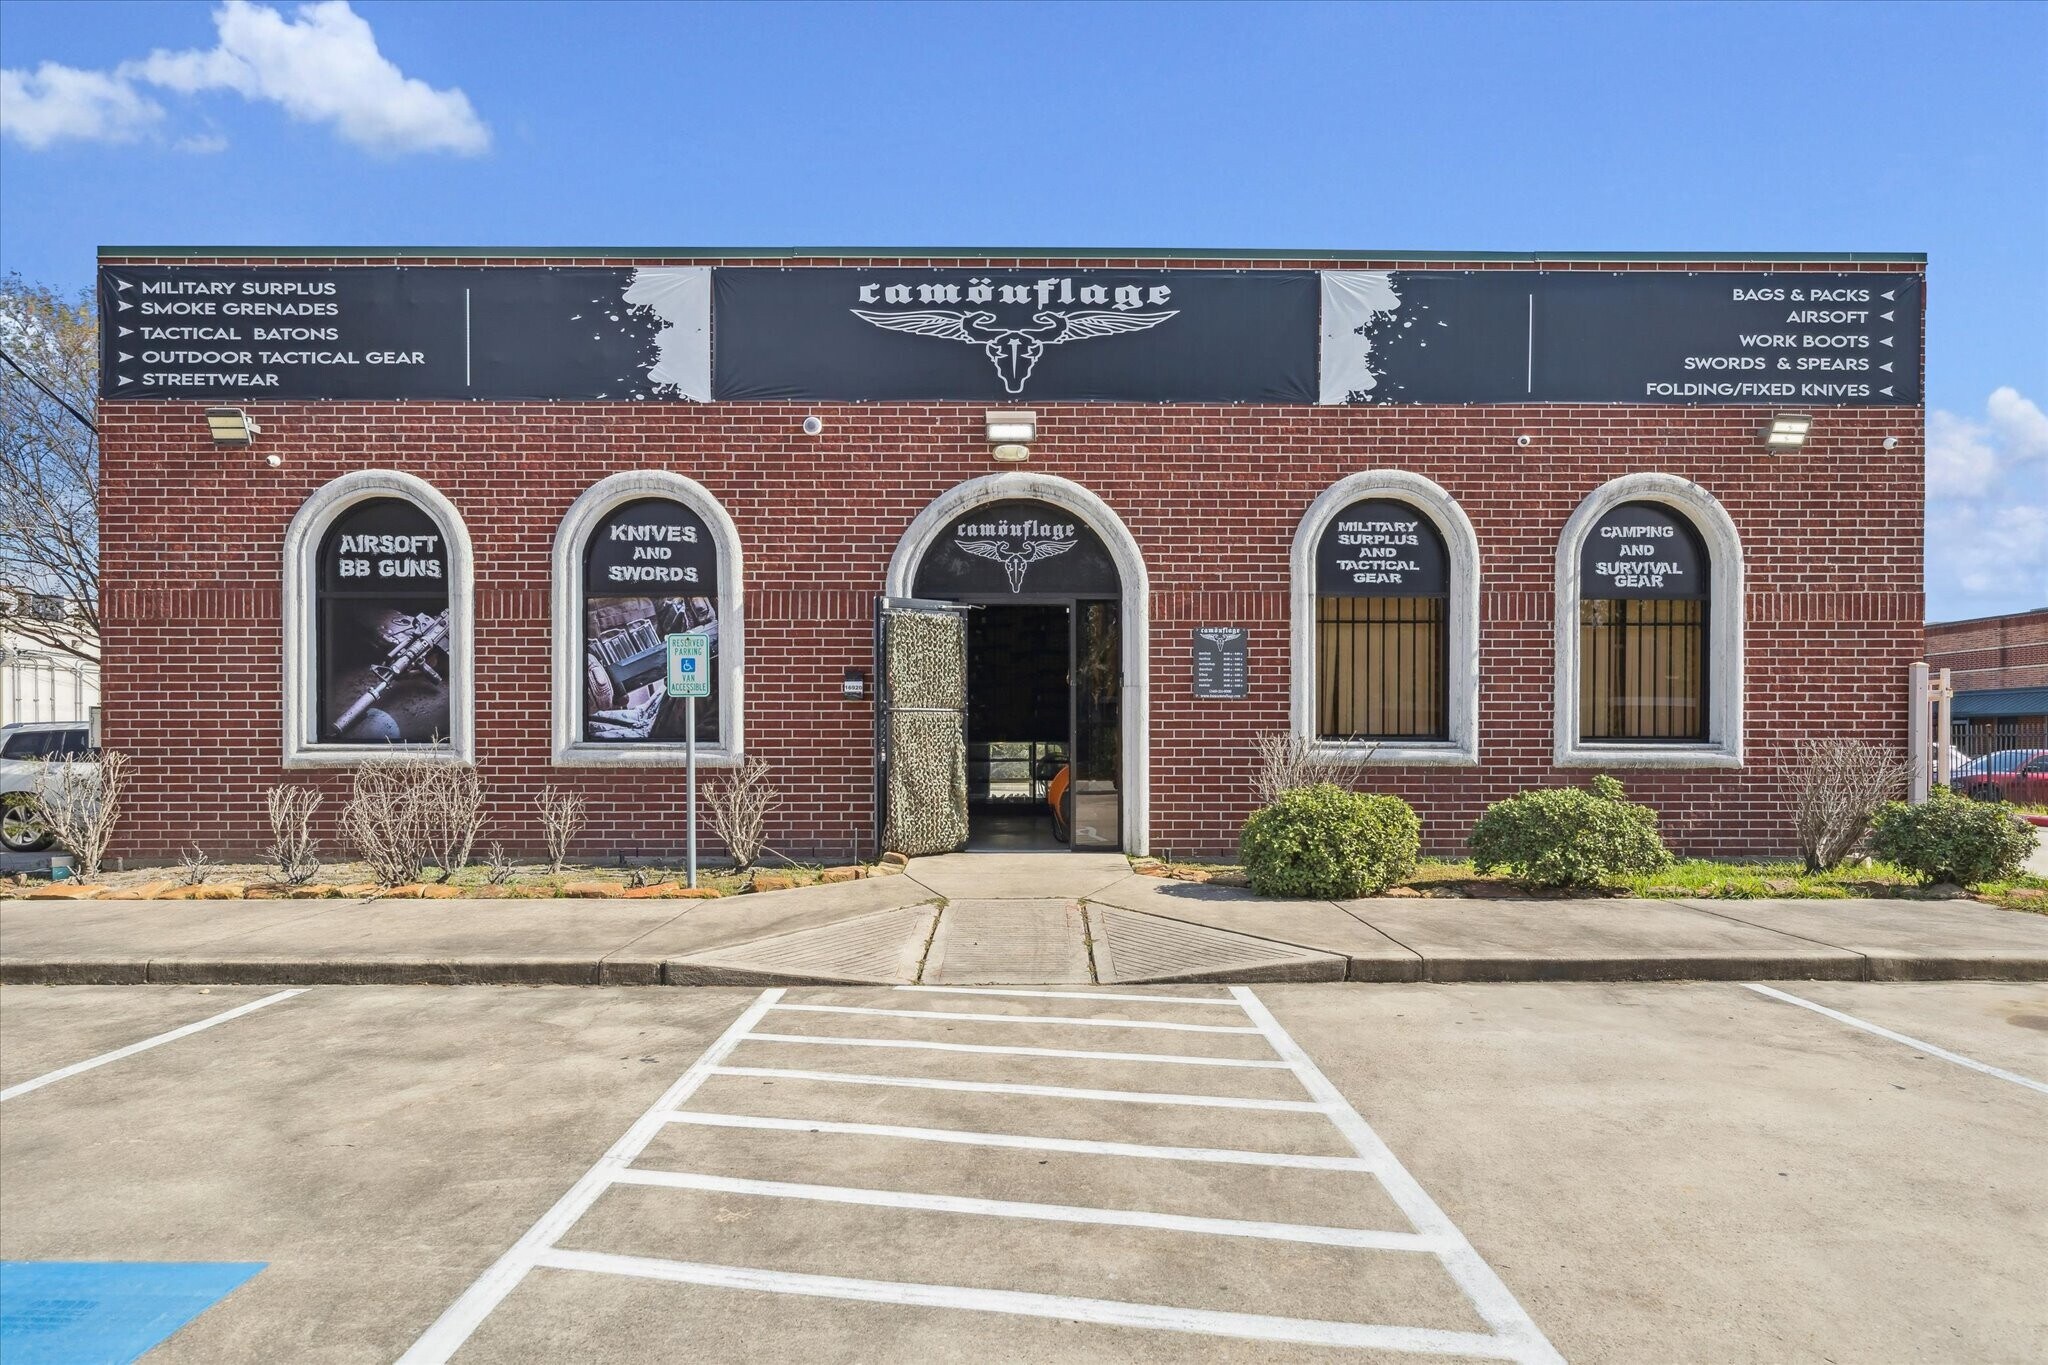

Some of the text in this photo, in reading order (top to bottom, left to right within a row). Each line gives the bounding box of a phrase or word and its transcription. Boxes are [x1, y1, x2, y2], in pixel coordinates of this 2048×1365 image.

[142, 281, 337, 296] MILITARY SURPLUS
[1732, 289, 1870, 302] BAGS & PACKS
[141, 302, 339, 316] SMOKE GRENADES
[1786, 311, 1869, 323] AIRSOFT
[140, 327, 339, 340] TACTICAL BATONS
[1739, 335, 1869, 348] WORK BOOTS
[142, 351, 425, 364] OUTDOOR TACTICAL GEAR
[1684, 357, 1869, 371] SWORDS & SPEARS
[142, 373, 279, 386] STREETWEAR
[1646, 383, 1870, 396] FOLDING/FIXED KNIVES
[1338, 521, 1418, 532] MILITARY
[1600, 526, 1673, 538] CAMPING
[609, 524, 697, 543] KNIVES
[1338, 534, 1418, 545] SURPLUS
[339, 535, 438, 554] AIRSOFT
[1620, 545, 1654, 556] AND
[633, 547, 672, 560] AND
[1359, 548, 1397, 557] AND
[339, 558, 442, 578] BB GUNS
[1336, 560, 1419, 570] TACTICAL
[1596, 561, 1683, 575] SURVIVAL
[608, 565, 698, 582] SWORDS
[1353, 573, 1402, 584] GEAR
[1614, 575, 1664, 588] GEAR
[672, 639, 704, 647] RESERVED
[672, 683, 706, 691] ACCESSIBLE
